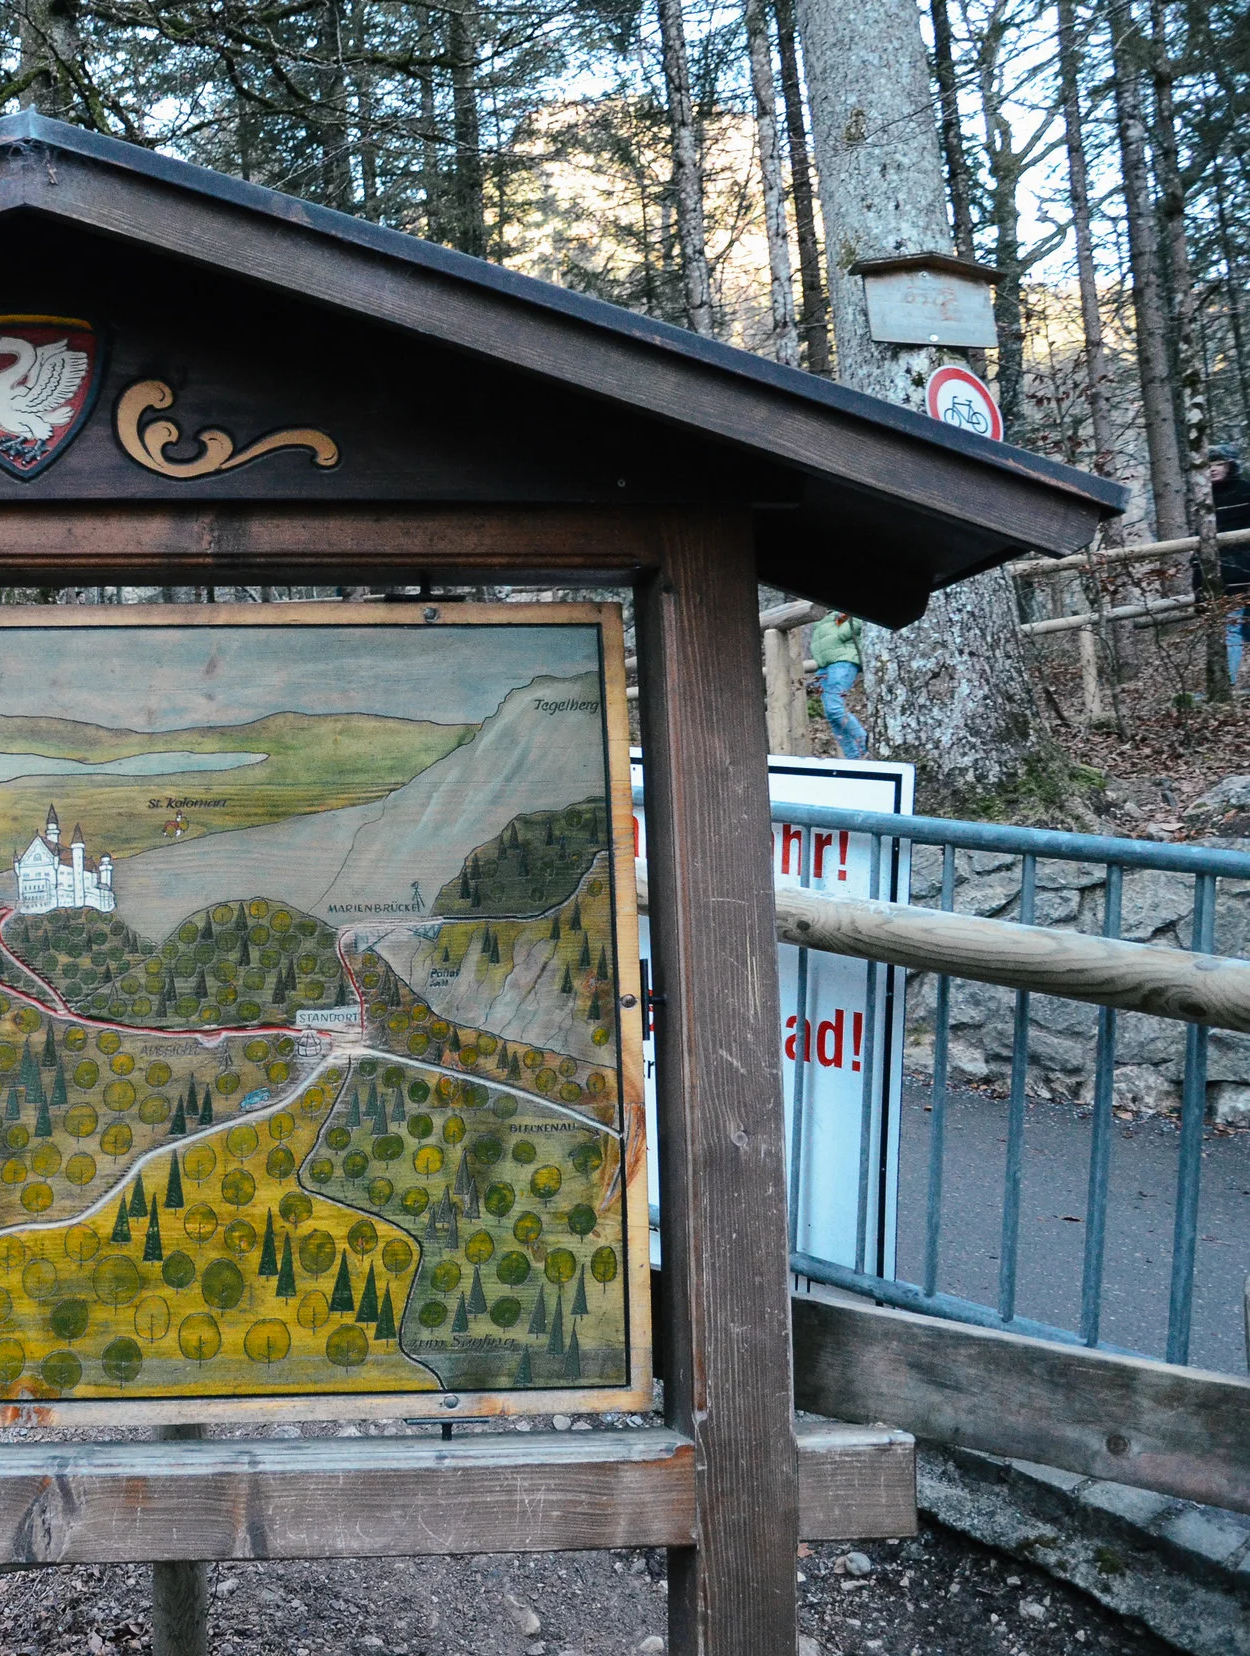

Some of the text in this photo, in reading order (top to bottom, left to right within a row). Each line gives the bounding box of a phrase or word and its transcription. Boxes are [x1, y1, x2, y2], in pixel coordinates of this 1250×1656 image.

[534, 698, 600, 716] Tegelberg
[147, 796, 228, 809] St. Koloman
[770, 823, 849, 881] hr!
[327, 900, 419, 913] MARIENBRÜCKE
[299, 1012, 360, 1024] STANDORT
[784, 1008, 863, 1073] ad!
[510, 1122, 578, 1134] BLECKENAU
